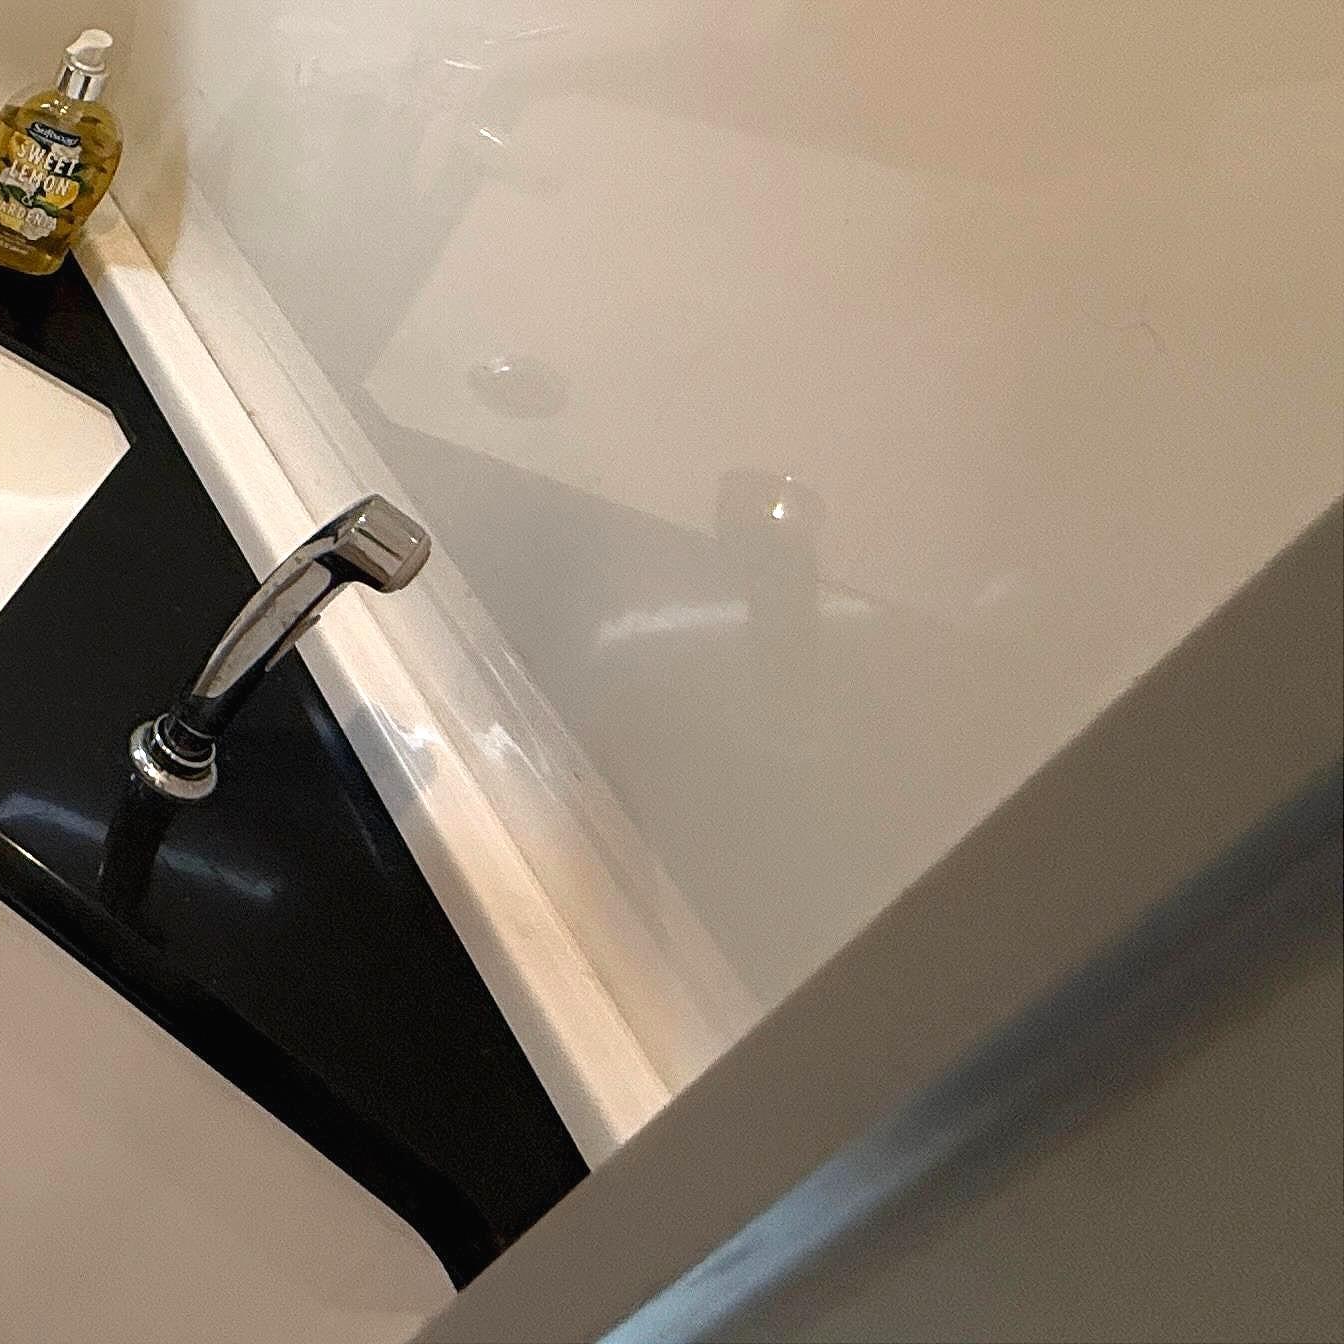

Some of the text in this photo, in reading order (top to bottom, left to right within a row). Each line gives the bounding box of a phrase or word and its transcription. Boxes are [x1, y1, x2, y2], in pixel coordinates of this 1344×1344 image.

[16, 143, 79, 176] SWEET
[9, 159, 69, 196] LEMON
[21, 195, 33, 206] &
